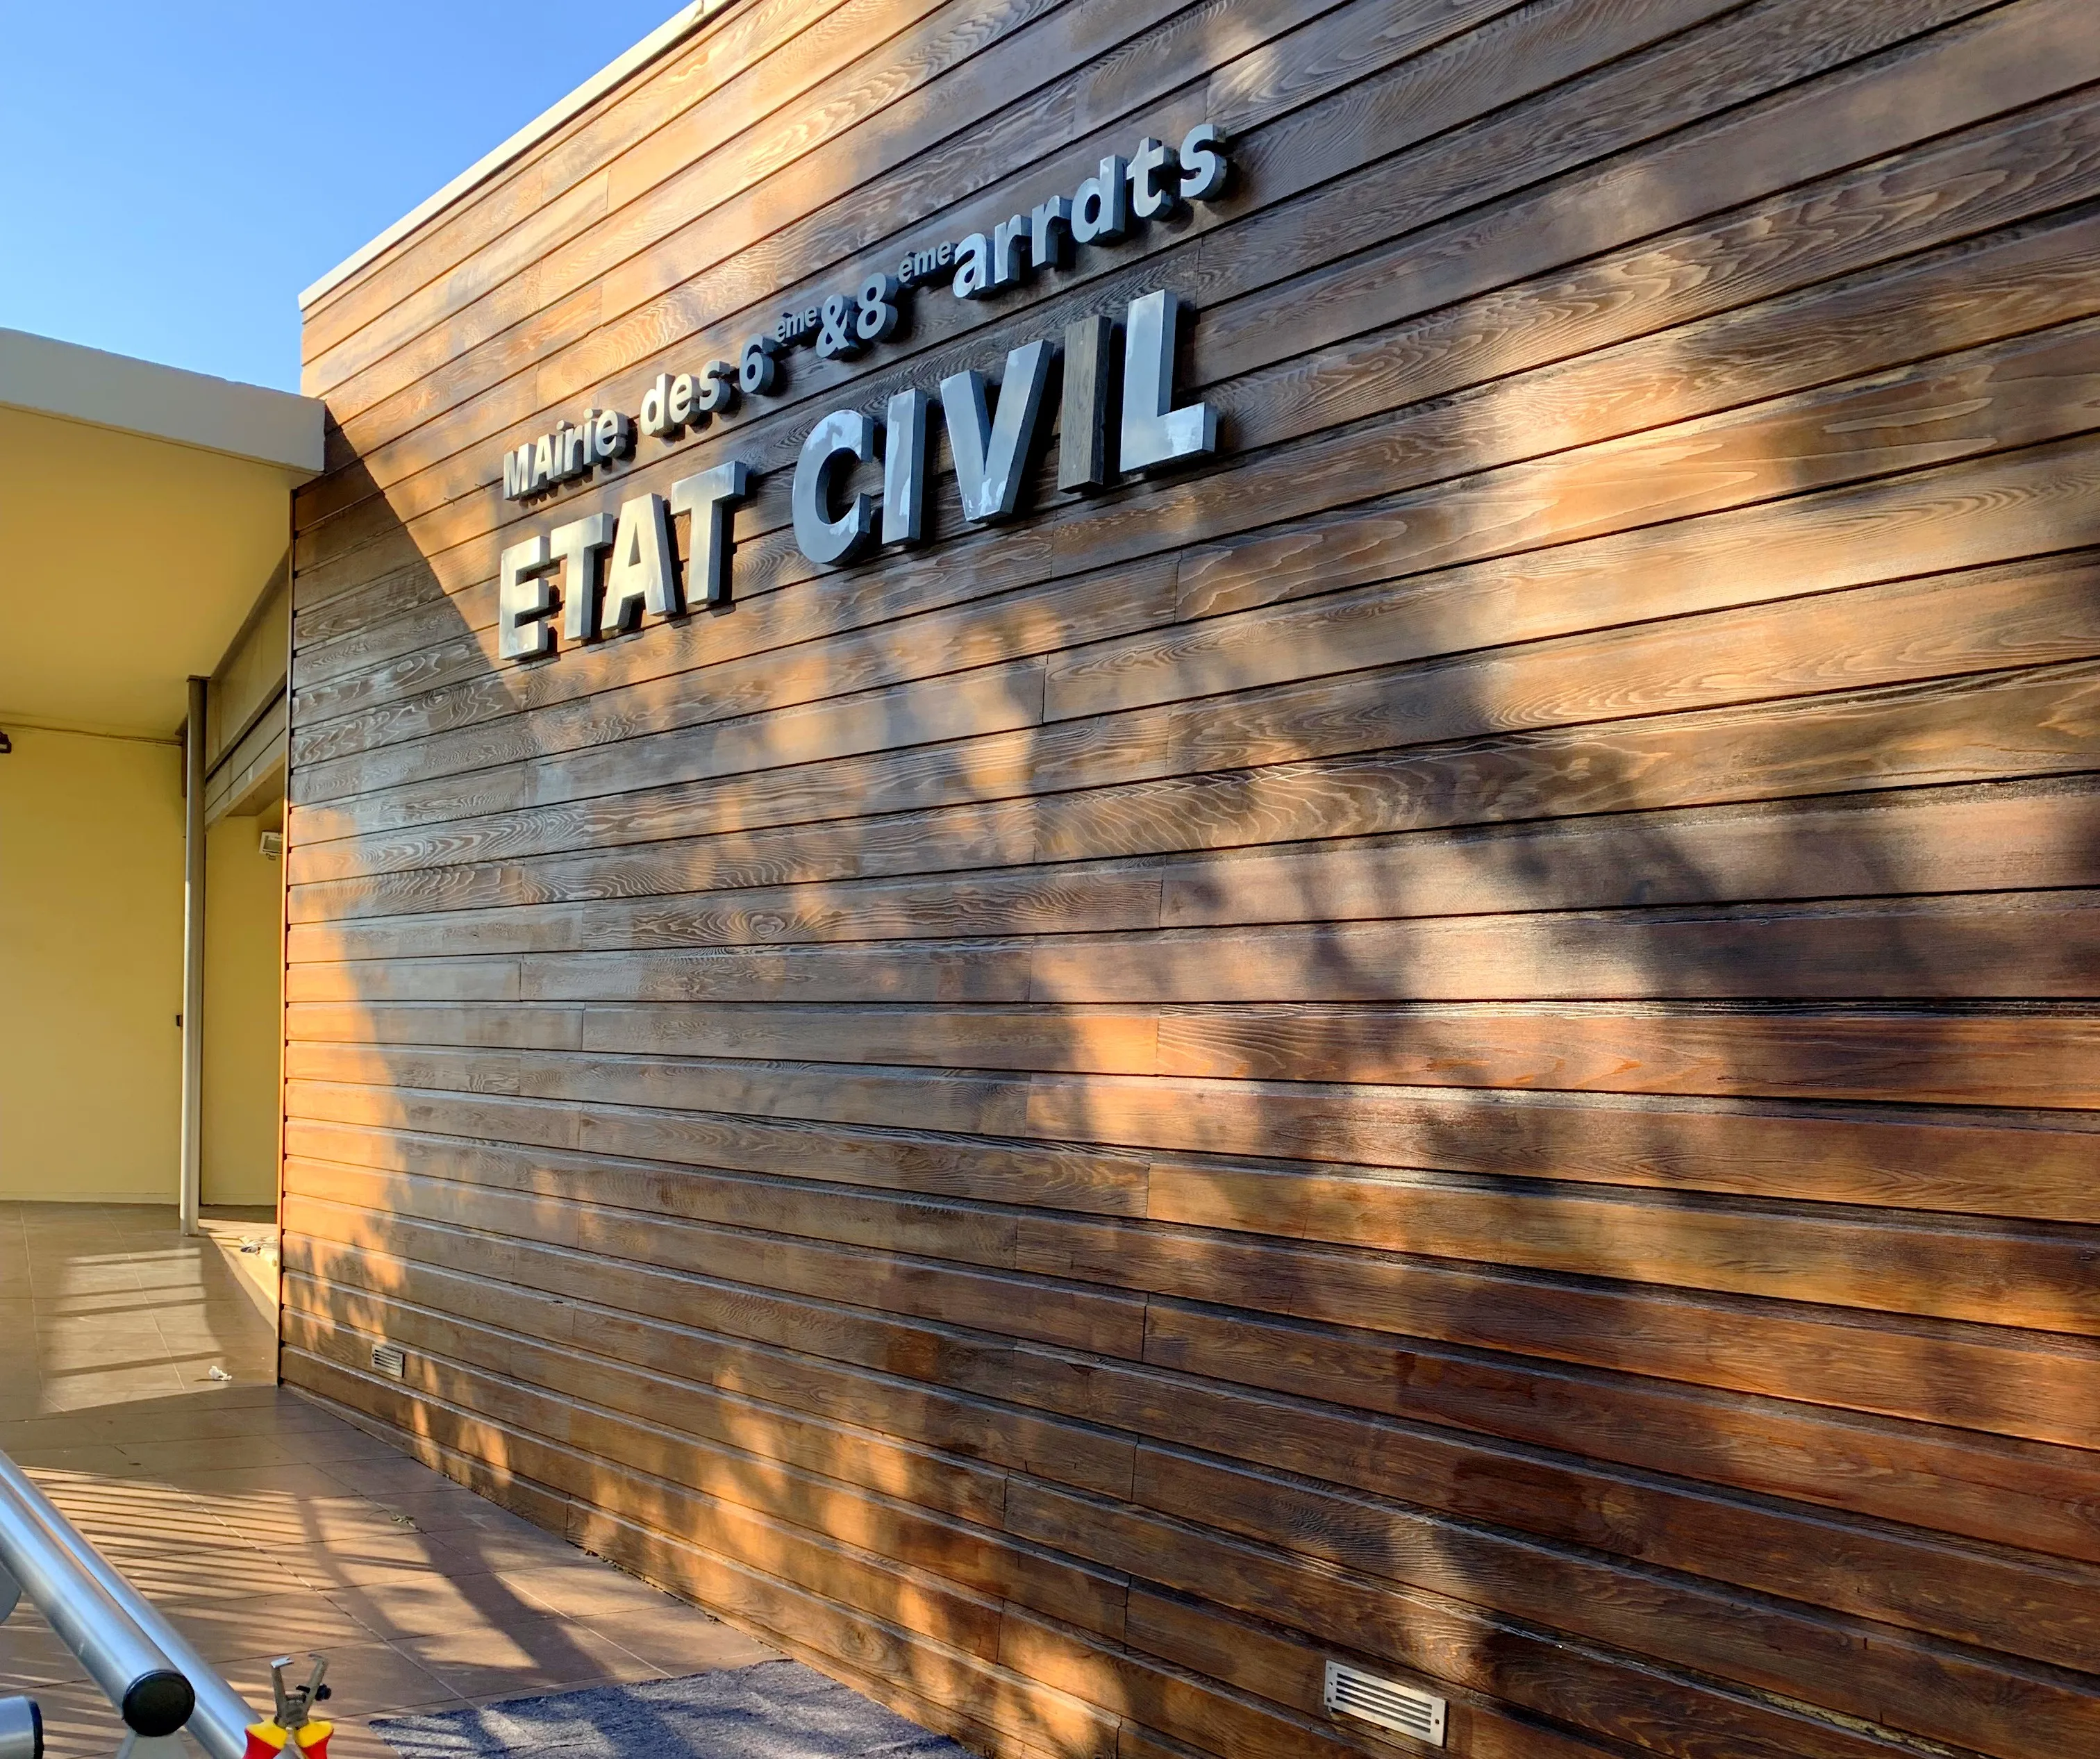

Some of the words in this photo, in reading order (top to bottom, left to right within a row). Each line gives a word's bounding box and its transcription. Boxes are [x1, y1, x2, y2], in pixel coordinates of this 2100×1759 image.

[499, 460, 746, 661] ETAT
[792, 289, 1217, 564] CIVIL
[503, 401, 629, 501] MAirie
[640, 360, 731, 437] des
[952, 124, 1228, 299] arrdts
